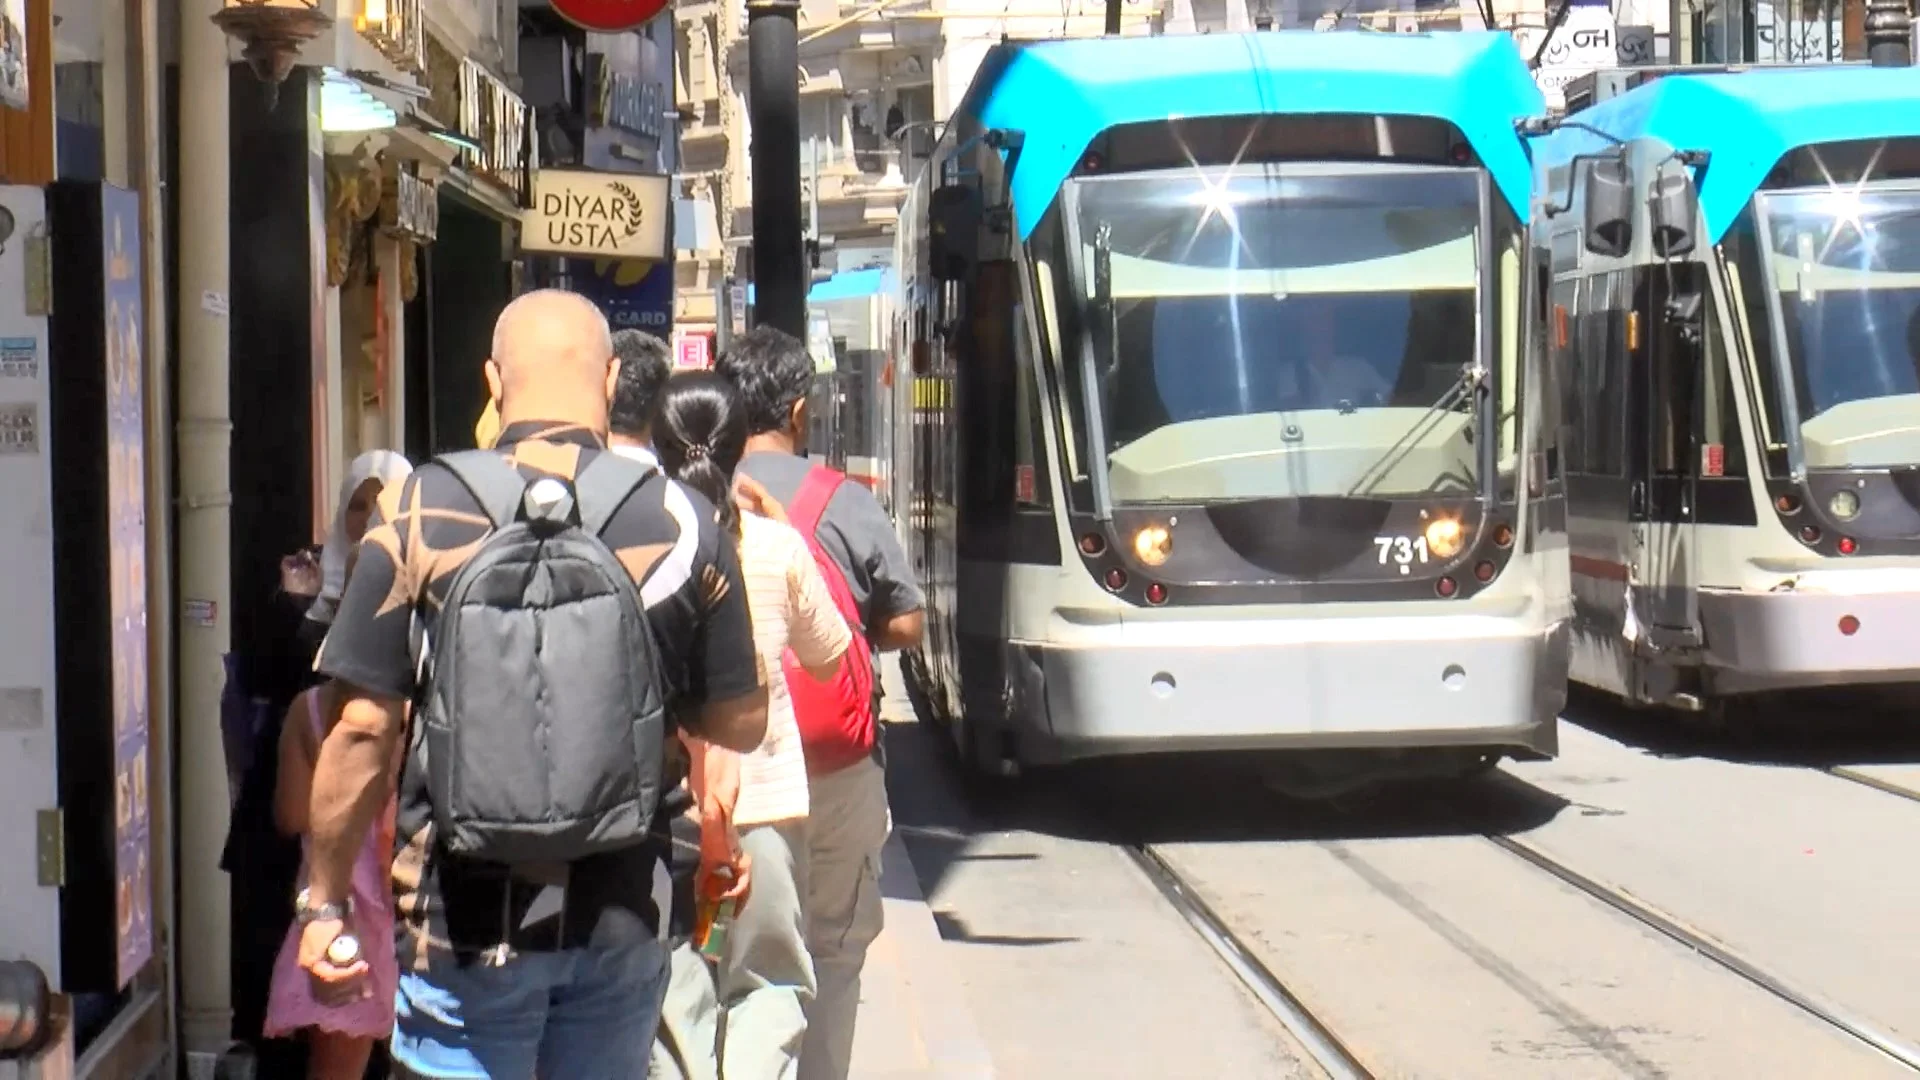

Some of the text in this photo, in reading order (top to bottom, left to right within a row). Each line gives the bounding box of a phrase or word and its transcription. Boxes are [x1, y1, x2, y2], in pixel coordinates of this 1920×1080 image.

[543, 187, 625, 221] DİYAR
[547, 221, 618, 249] USTA
[615, 311, 667, 325] CARD
[1373, 536, 1429, 564] 731
